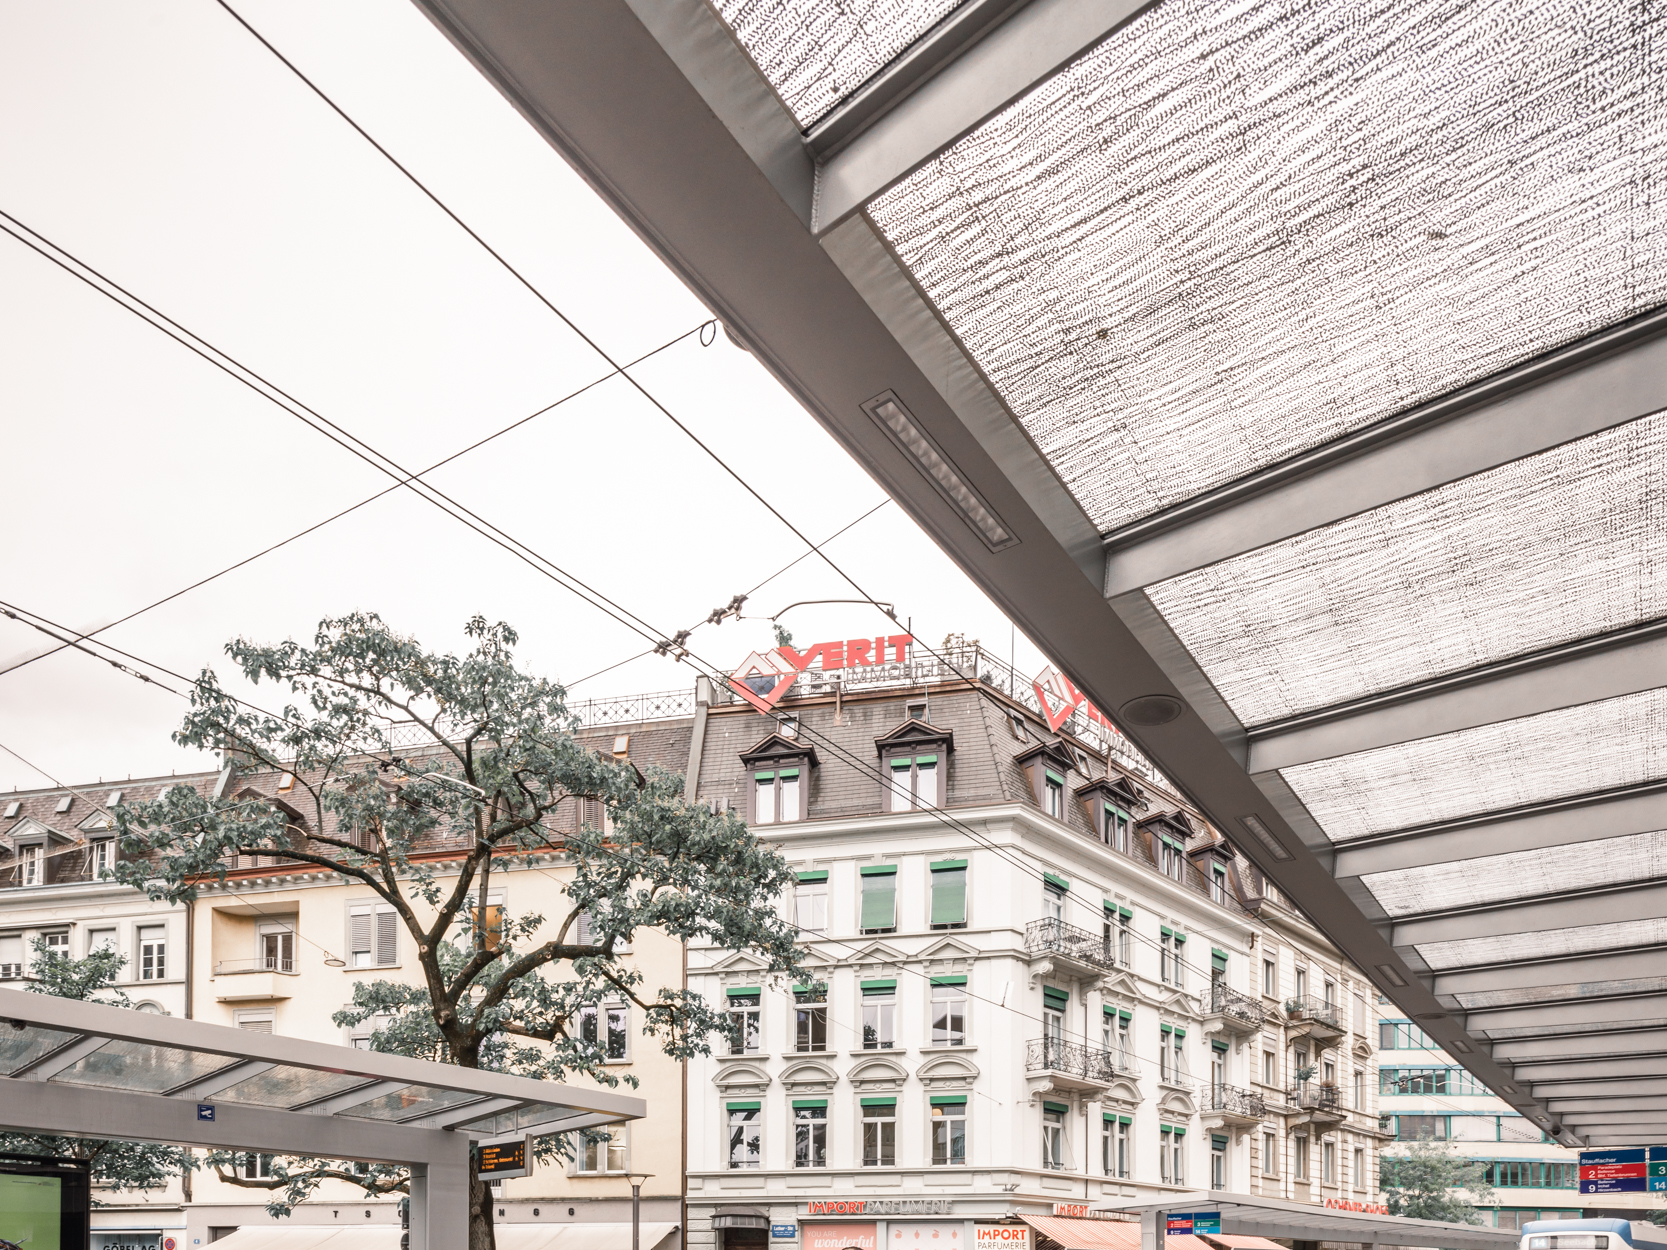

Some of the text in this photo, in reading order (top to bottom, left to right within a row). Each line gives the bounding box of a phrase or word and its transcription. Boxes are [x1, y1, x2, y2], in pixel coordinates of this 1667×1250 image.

[777, 633, 914, 672] VERIT
[847, 658, 964, 684] IMMOBILIEN
[1588, 1170, 1596, 1179] 2
[1658, 1166, 1666, 1175] 3
[1588, 1184, 1596, 1193] 9
[1654, 1181, 1667, 1190] 14
[808, 1200, 953, 1214] IMPORT PARFUMERIE
[1056, 1203, 1089, 1217] IMPORT
[806, 1230, 822, 1238] YOU
[977, 1229, 1027, 1241] IMPORT
[814, 1235, 874, 1248] wonderful
[977, 1241, 1027, 1250] PARFUMERIE
[1533, 1238, 1546, 1247] 14
